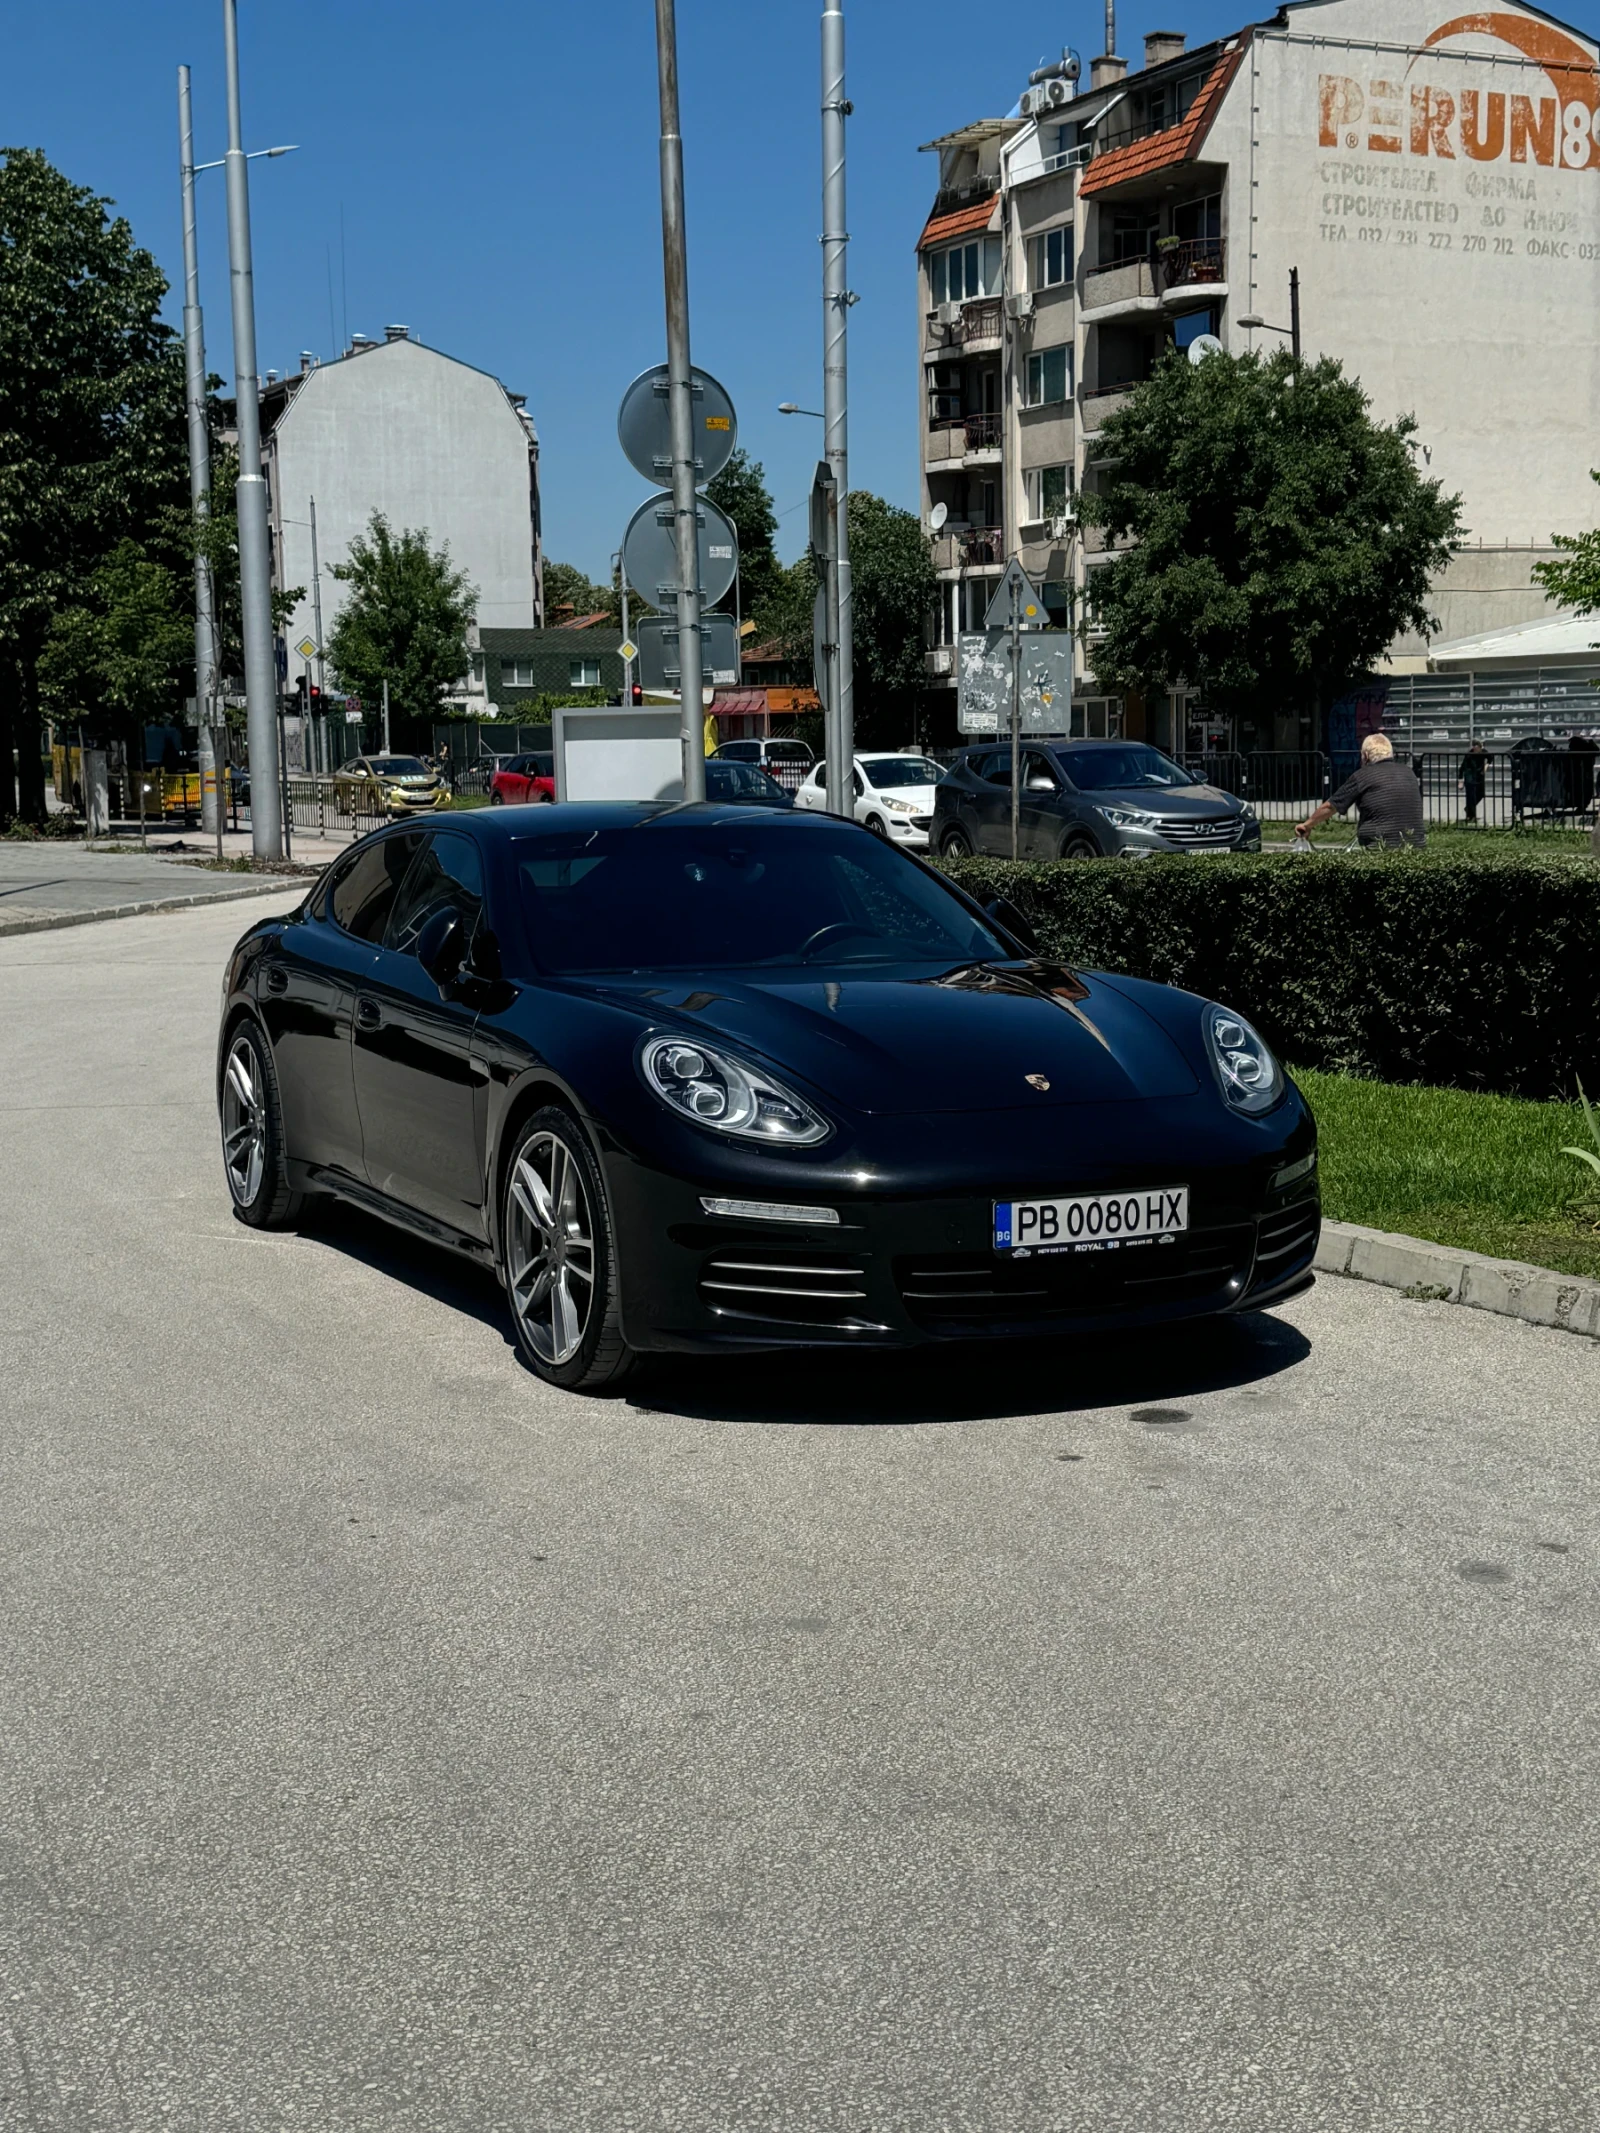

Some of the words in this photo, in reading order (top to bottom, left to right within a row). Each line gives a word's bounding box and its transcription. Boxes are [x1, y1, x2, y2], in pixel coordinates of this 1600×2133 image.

[1465, 171, 1537, 200] ФИРМА
[1322, 193, 1459, 223] СТРОИТЕЛСТВО
[1480, 205, 1506, 228] ДО
[1428, 232, 1453, 249] 272
[1462, 234, 1486, 252] 270
[1493, 237, 1514, 255] 212
[1067, 1198, 1141, 1237] 0080
[996, 1231, 1011, 1242] BG
[1074, 1242, 1105, 1253] ROYAL
